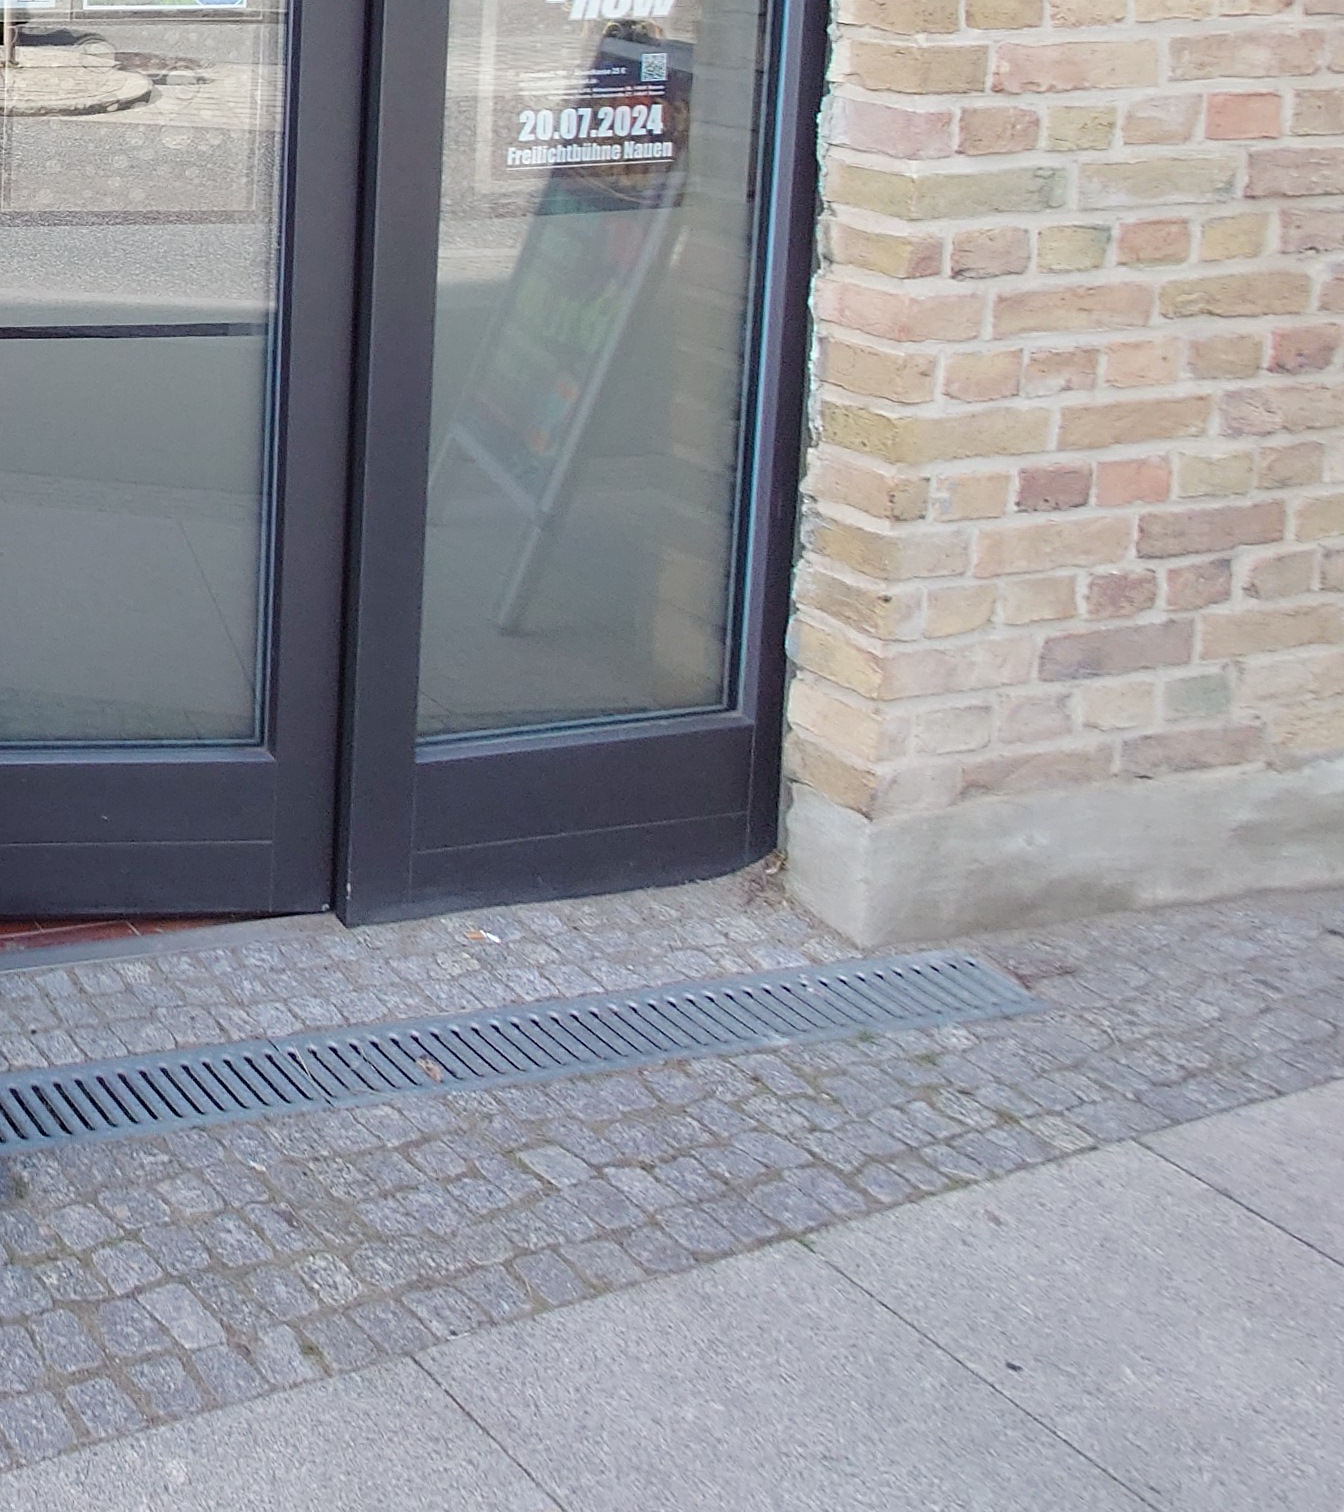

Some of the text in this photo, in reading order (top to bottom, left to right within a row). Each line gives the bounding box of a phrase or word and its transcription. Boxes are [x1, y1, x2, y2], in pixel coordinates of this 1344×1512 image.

[518, 104, 664, 142] 20.07.2024
[507, 141, 674, 166] Freilichtbühne Nauen
